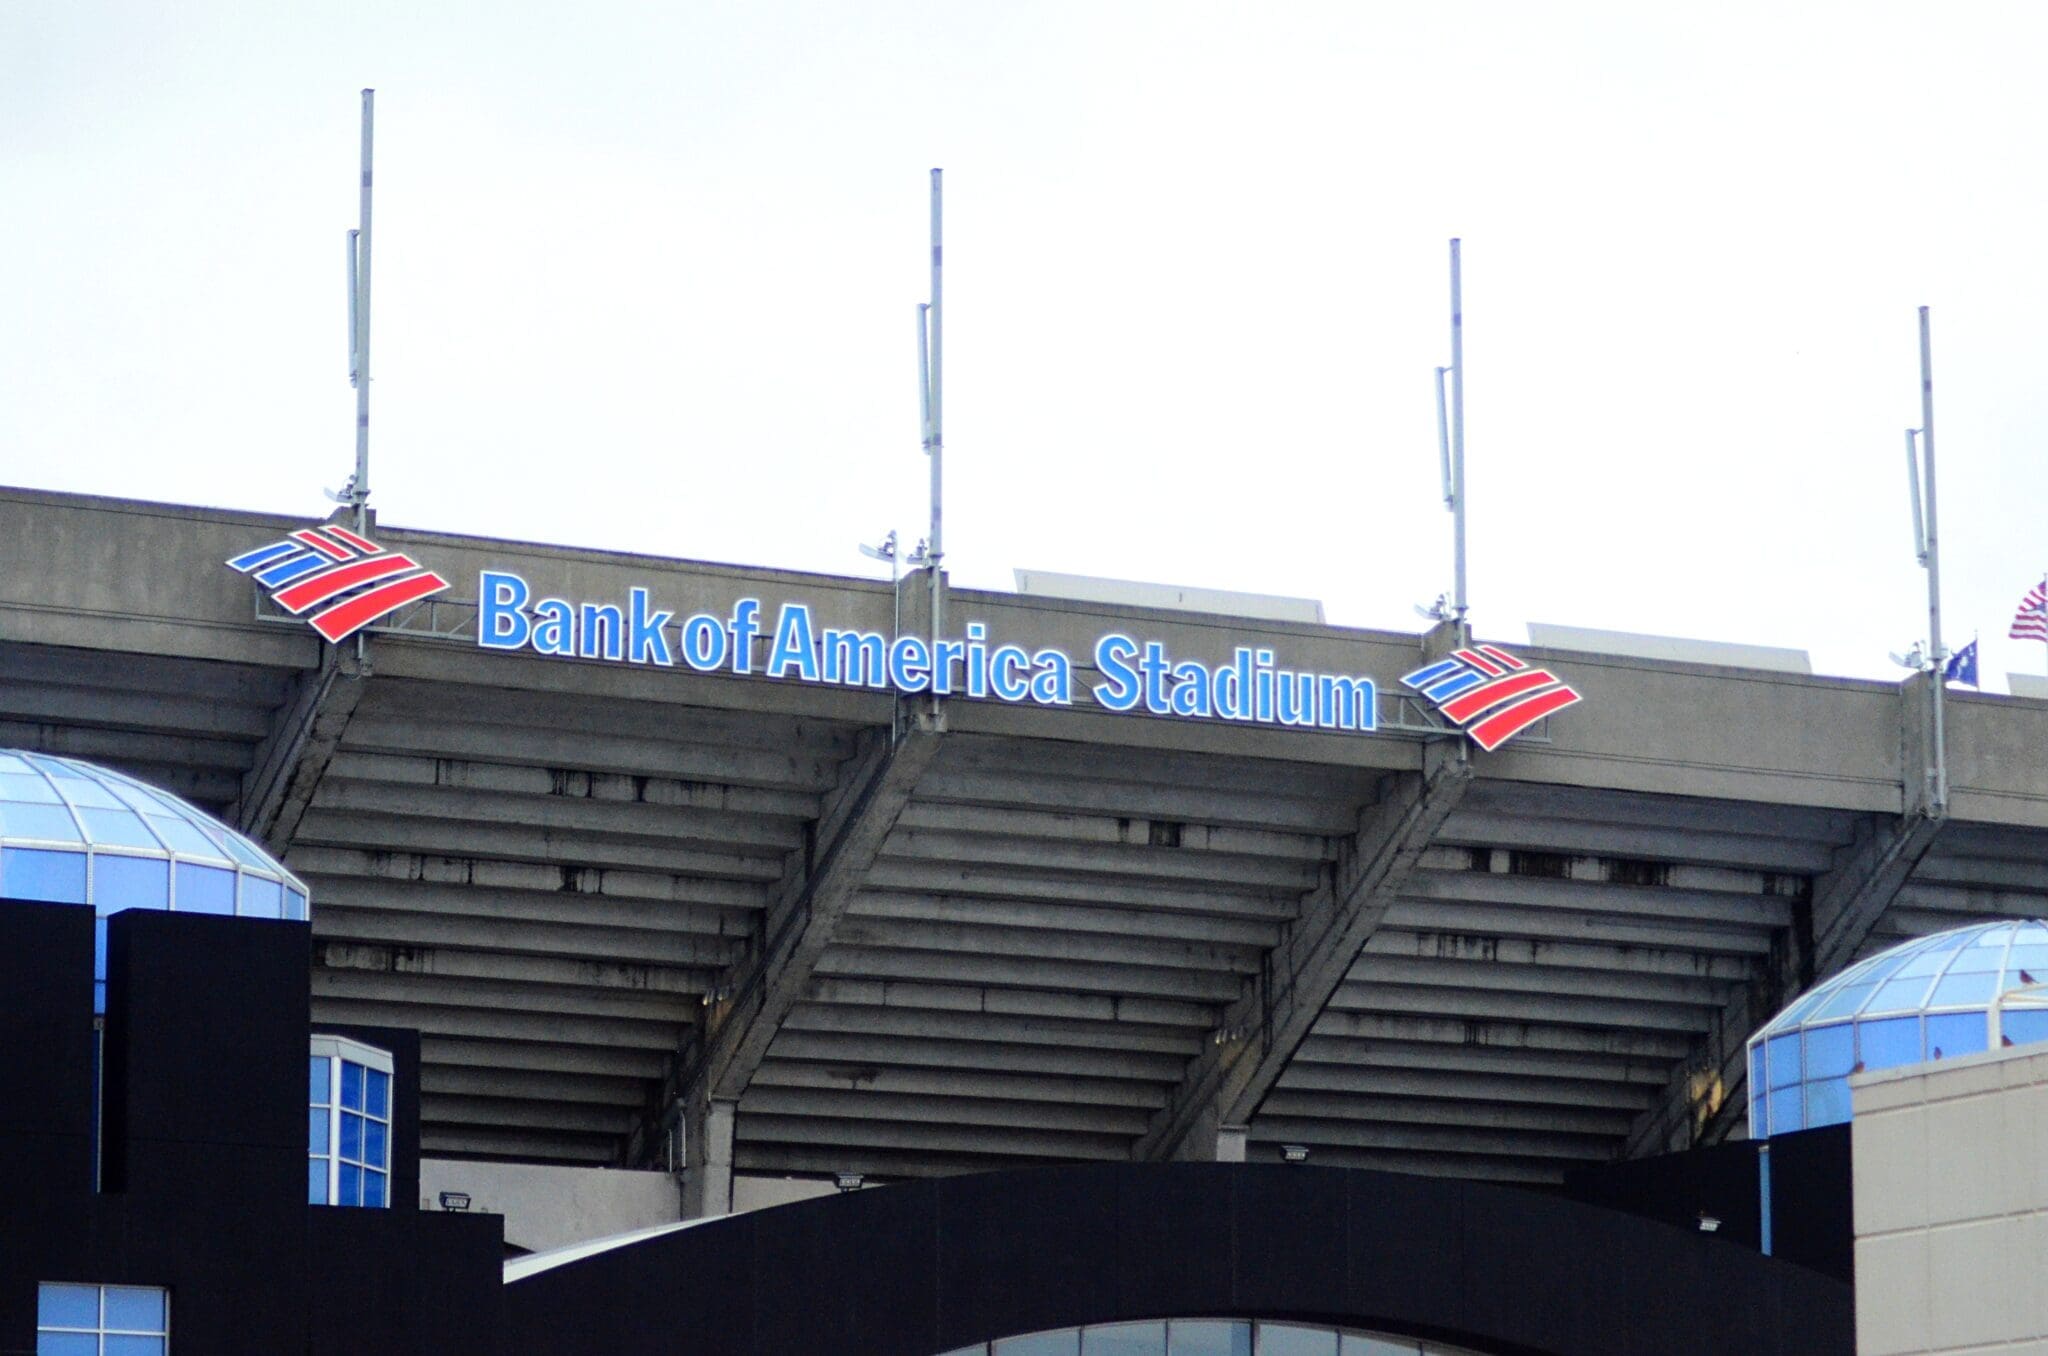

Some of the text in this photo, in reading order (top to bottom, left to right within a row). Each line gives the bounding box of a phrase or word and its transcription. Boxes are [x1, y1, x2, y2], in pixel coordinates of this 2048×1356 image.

[478, 570, 1377, 731] Bank of America Stadium
